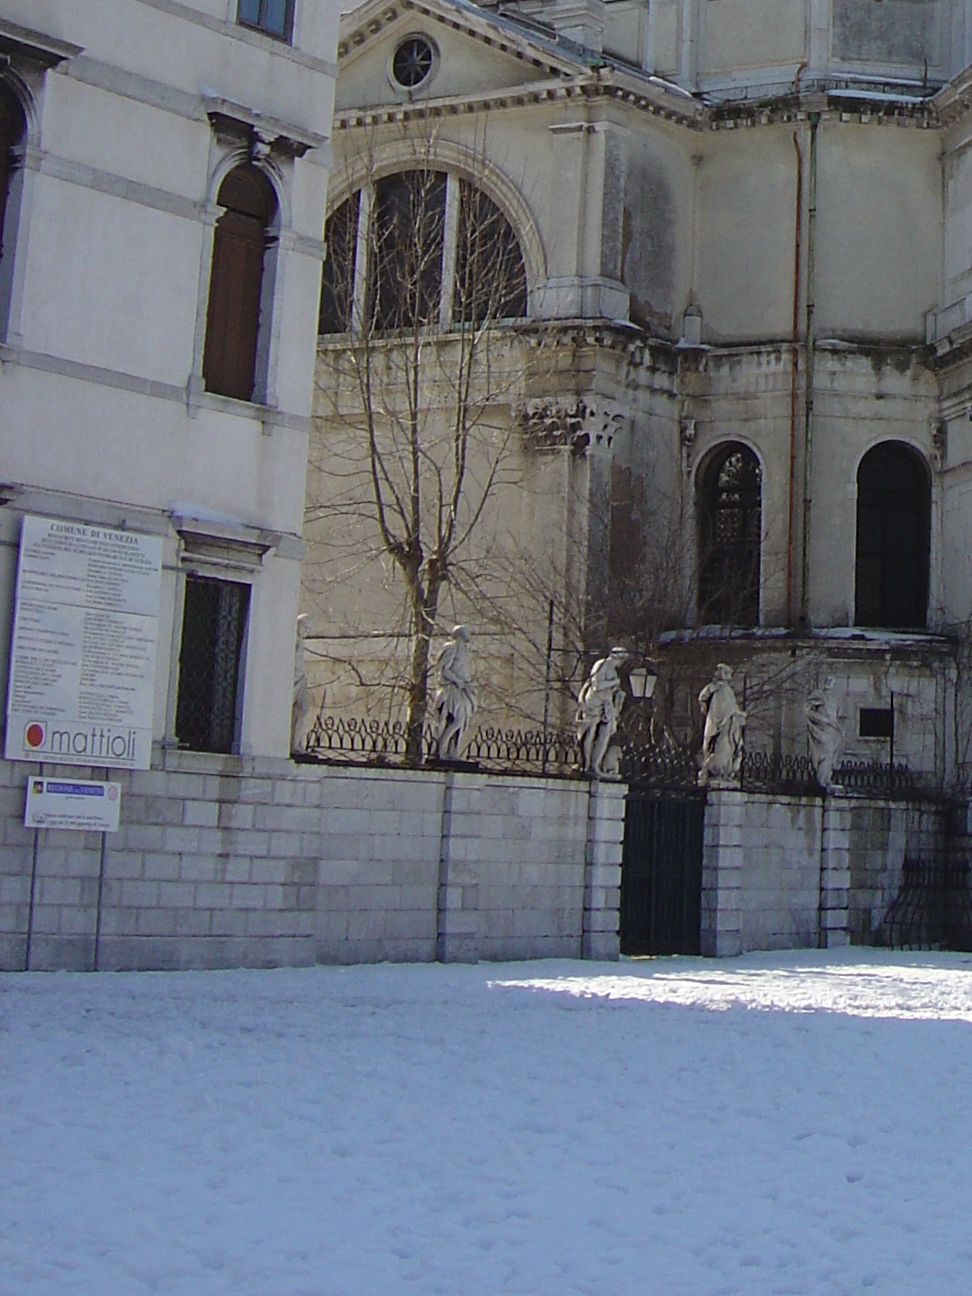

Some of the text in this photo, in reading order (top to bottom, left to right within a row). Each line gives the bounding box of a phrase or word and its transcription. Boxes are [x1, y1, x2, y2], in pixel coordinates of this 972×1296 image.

[51, 523, 87, 536] COMUNE
[91, 530, 100, 538] DI
[103, 532, 138, 545] VENEZIA
[51, 727, 136, 758] mattioli
